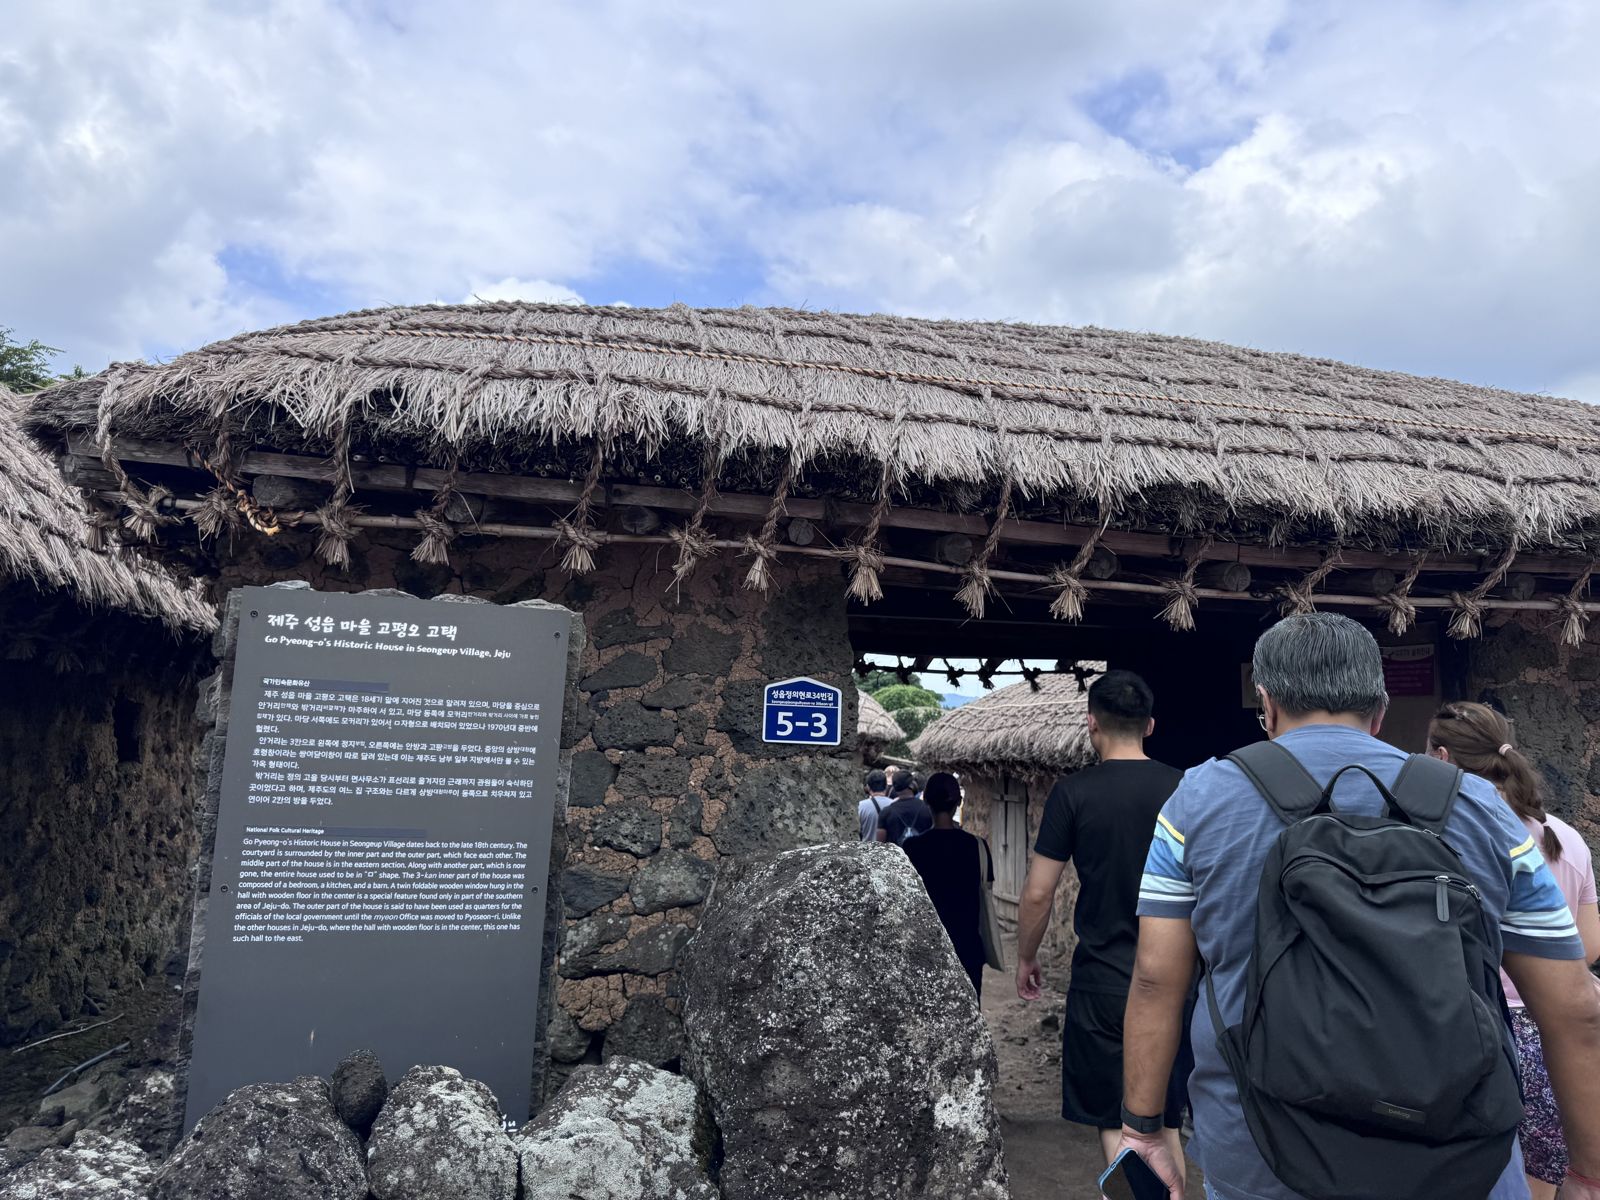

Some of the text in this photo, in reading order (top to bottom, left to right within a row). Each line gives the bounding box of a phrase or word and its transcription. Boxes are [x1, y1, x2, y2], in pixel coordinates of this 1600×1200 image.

[268, 614, 457, 640] 제주 성읍 마을 고평오 고택
[280, 636, 331, 647] Pyeong-o's
[334, 640, 373, 649] Historic
[375, 643, 404, 651] House
[406, 644, 415, 652] in
[417, 645, 458, 656] Seongeup
[460, 648, 492, 658] Village,
[494, 650, 511, 659] Jeju
[776, 711, 828, 738] 5-3
[254, 838, 292, 846] Pyeong-o's
[350, 840, 382, 848] Seongeup
[383, 841, 405, 849] Village
[366, 849, 380, 858] part
[408, 862, 427, 870] Along
[274, 871, 295, 879] entire
[416, 870, 437, 879] 3-kan
[238, 881, 273, 890] composed
[289, 881, 319, 889] bedroom,
[252, 892, 267, 900] with
[439, 893, 452, 901] only
[262, 902, 290, 911] Jeju-do.
[300, 924, 328, 932] Jeju-do,
